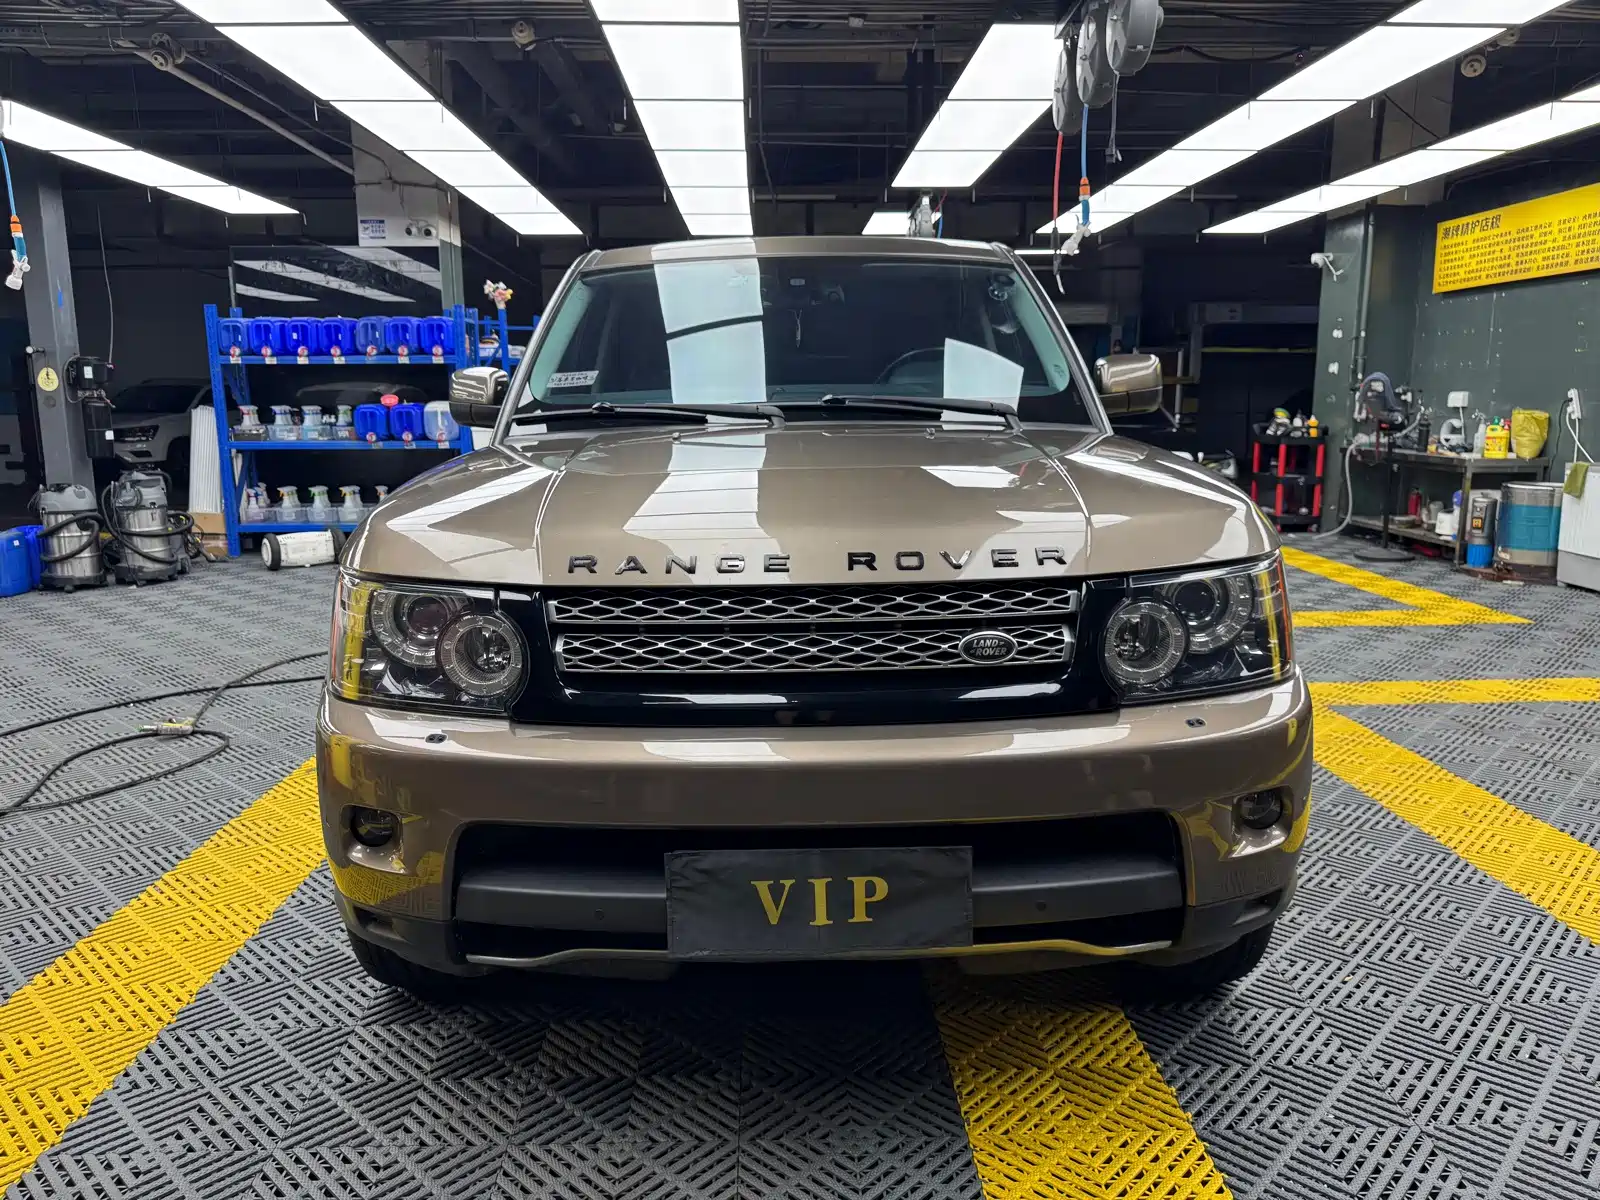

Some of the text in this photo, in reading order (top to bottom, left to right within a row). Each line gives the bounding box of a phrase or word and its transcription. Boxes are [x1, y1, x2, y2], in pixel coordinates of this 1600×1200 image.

[567, 545, 1068, 576] RANGE ROVER
[972, 639, 999, 647] LAND
[975, 647, 1007, 656] ROVER
[750, 876, 889, 926] VIP
